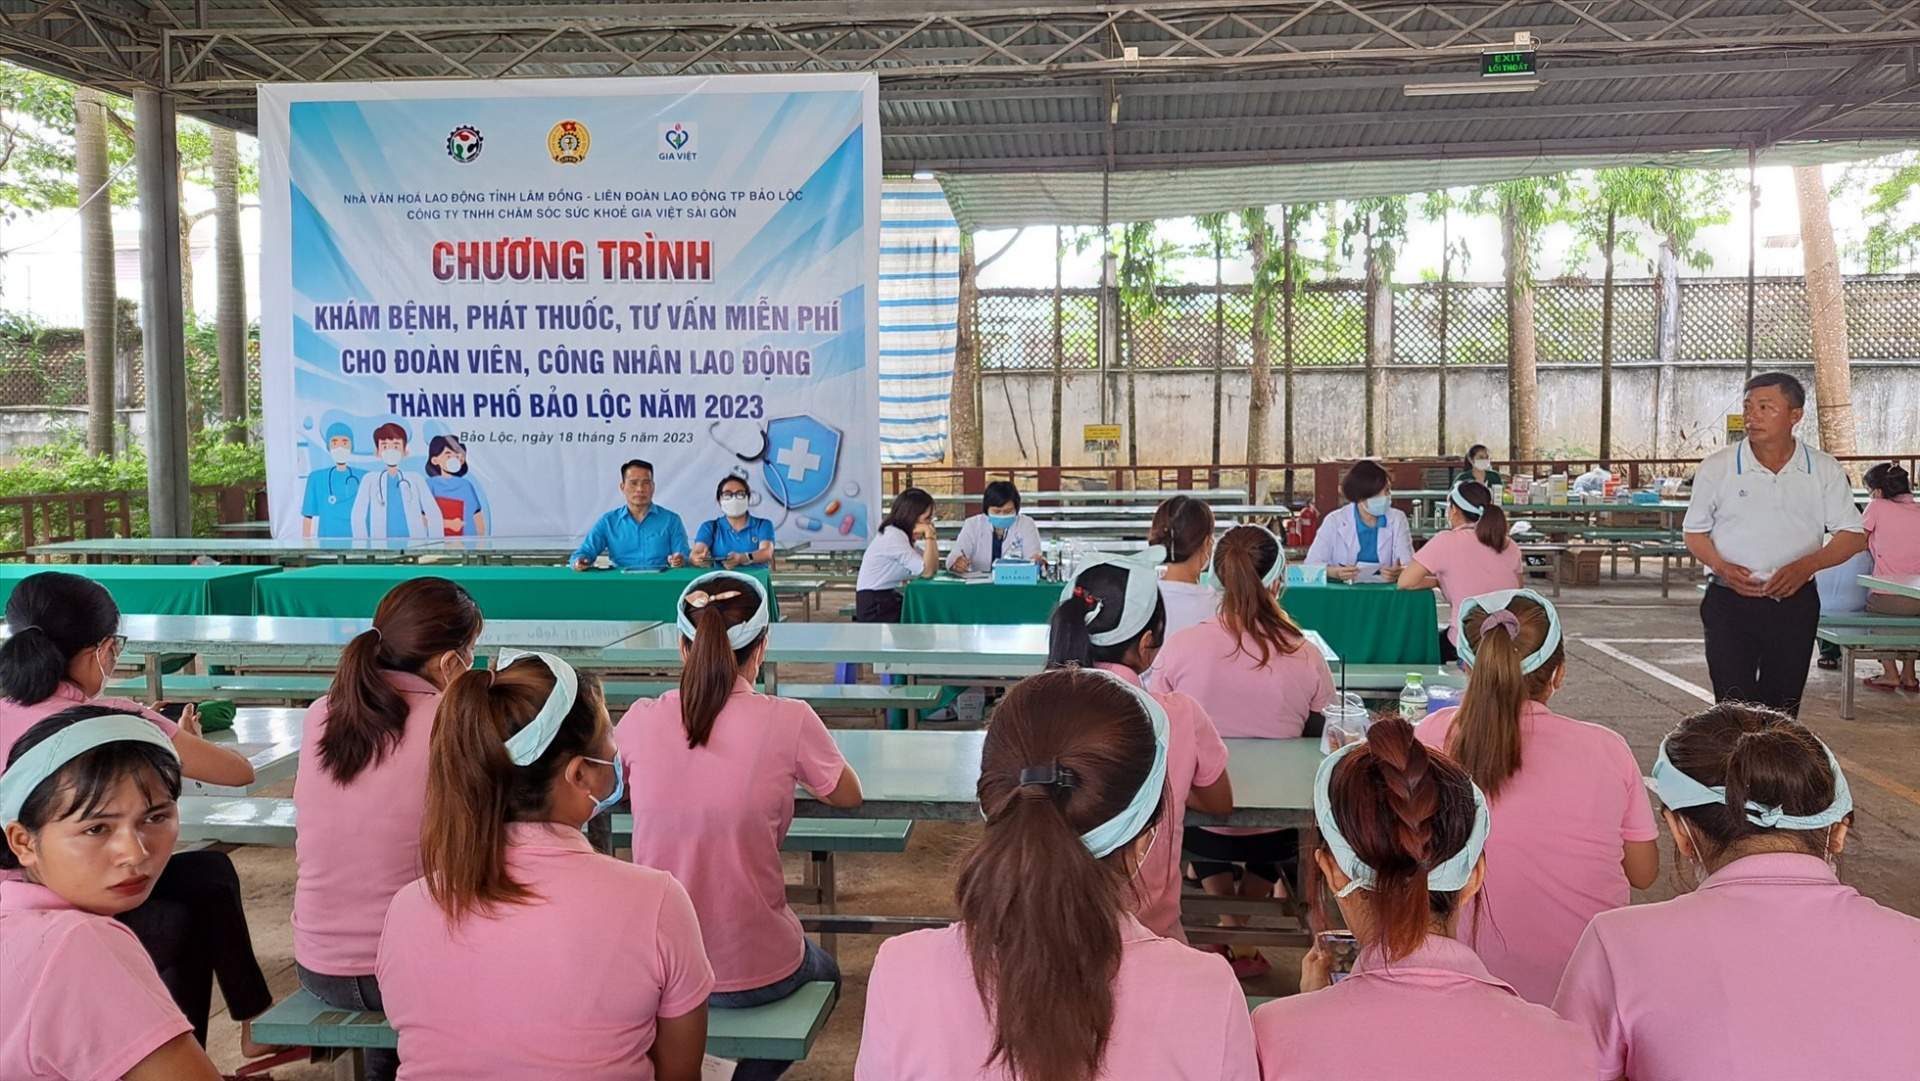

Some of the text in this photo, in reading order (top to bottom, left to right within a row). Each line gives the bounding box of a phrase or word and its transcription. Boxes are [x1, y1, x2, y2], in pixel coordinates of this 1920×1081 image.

[1494, 54, 1522, 63] EXIT
[659, 151, 697, 162] GIA VIỆT
[343, 191, 367, 204] NhÀ
[370, 191, 394, 204] VĂN
[397, 190, 422, 203] HOÁ
[425, 193, 448, 203] LAO
[451, 190, 485, 205] ĐỘNG
[489, 188, 516, 202] TỈNH
[520, 190, 544, 202] LÂM
[548, 187, 583, 202] ĐỒNG
[594, 189, 619, 201] LIÊN
[625, 189, 659, 201] ĐOÀN
[664, 191, 688, 201] LAO
[691, 189, 726, 203] ĐỘNG
[730, 191, 745, 201] TP
[749, 187, 775, 201] BẢO
[779, 188, 803, 202] LỘC
[407, 204, 736, 220] CÔNG TY TNHH CHĂM SÓC SỨC KHOẺ GIA VIỆT SÀI GÒN
[431, 232, 711, 281] CHƯƠNG TRÌNH
[315, 296, 839, 336] KHÁM BỆNH, PHÁT THUỐC, TƯ VẤN MIỄN PHÍ
[341, 344, 811, 381] CHO ĐOÀN VIÊN, CÔNG NHÂN LAO ĐỘNG
[387, 385, 764, 423] THÀNH PHỐ BẢO LỘC NĂM 2023
[459, 429, 694, 445] Bảo Lộc, ngày 18 tháng 5 năm 2023
